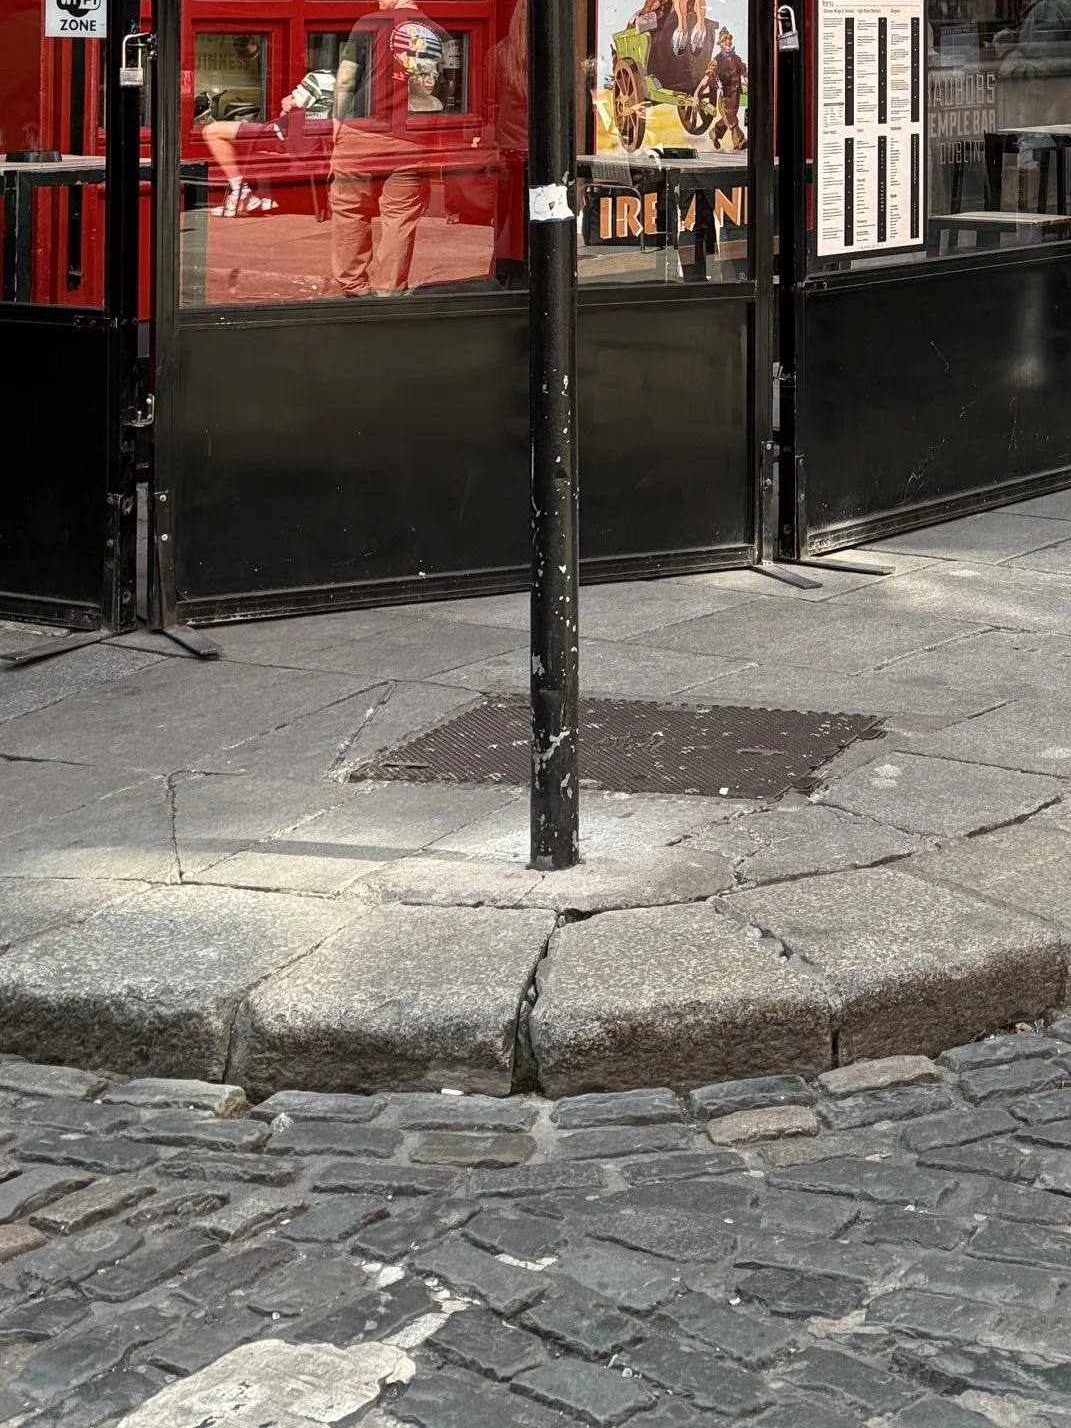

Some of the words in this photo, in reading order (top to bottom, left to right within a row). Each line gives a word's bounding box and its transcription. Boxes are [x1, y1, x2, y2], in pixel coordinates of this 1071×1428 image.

[60, 19, 97, 32] ZONE
[928, 71, 997, 107] ADBOBS
[928, 110, 970, 139] EMPLE
[973, 109, 997, 133] BAR
[599, 185, 748, 240] IREN
